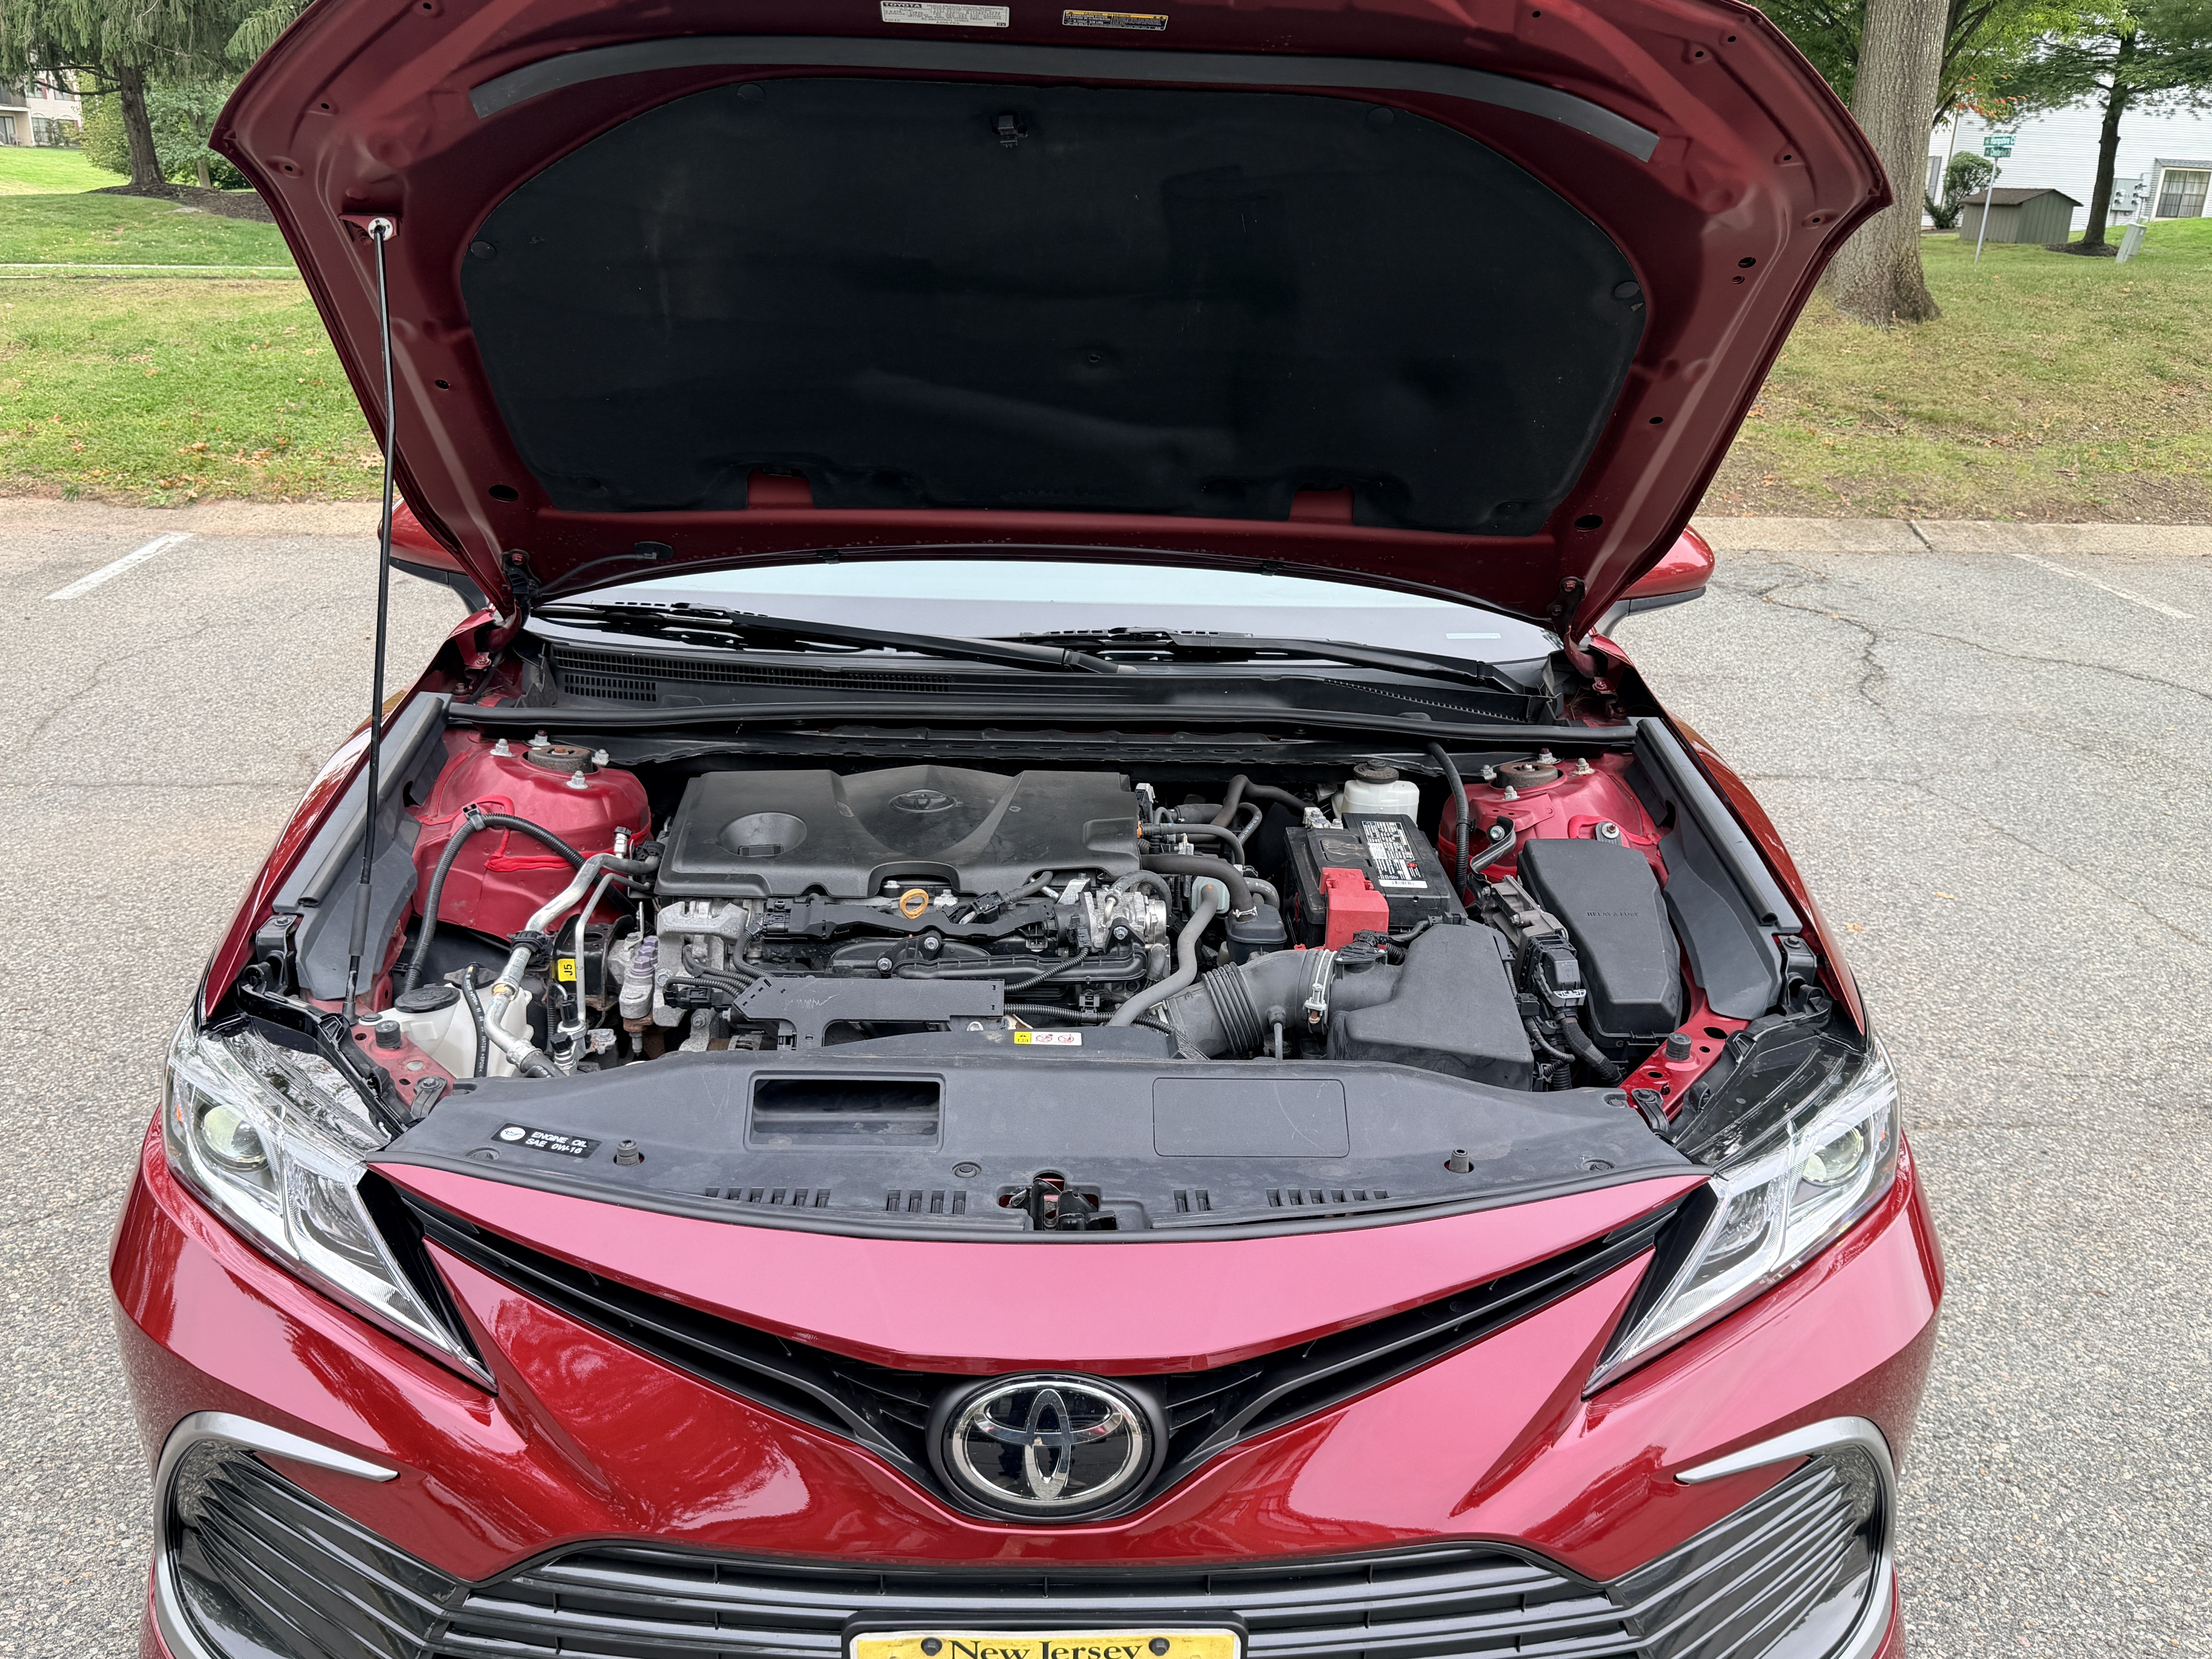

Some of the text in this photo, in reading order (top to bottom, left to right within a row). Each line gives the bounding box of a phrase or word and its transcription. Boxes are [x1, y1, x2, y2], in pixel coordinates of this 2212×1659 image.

[563, 964, 573, 976] J5
[525, 1138, 583, 1154] SAE 0W-16
[531, 1132, 587, 1148] ENGINE OIL
[948, 1640, 1144, 1659] New Jersey
